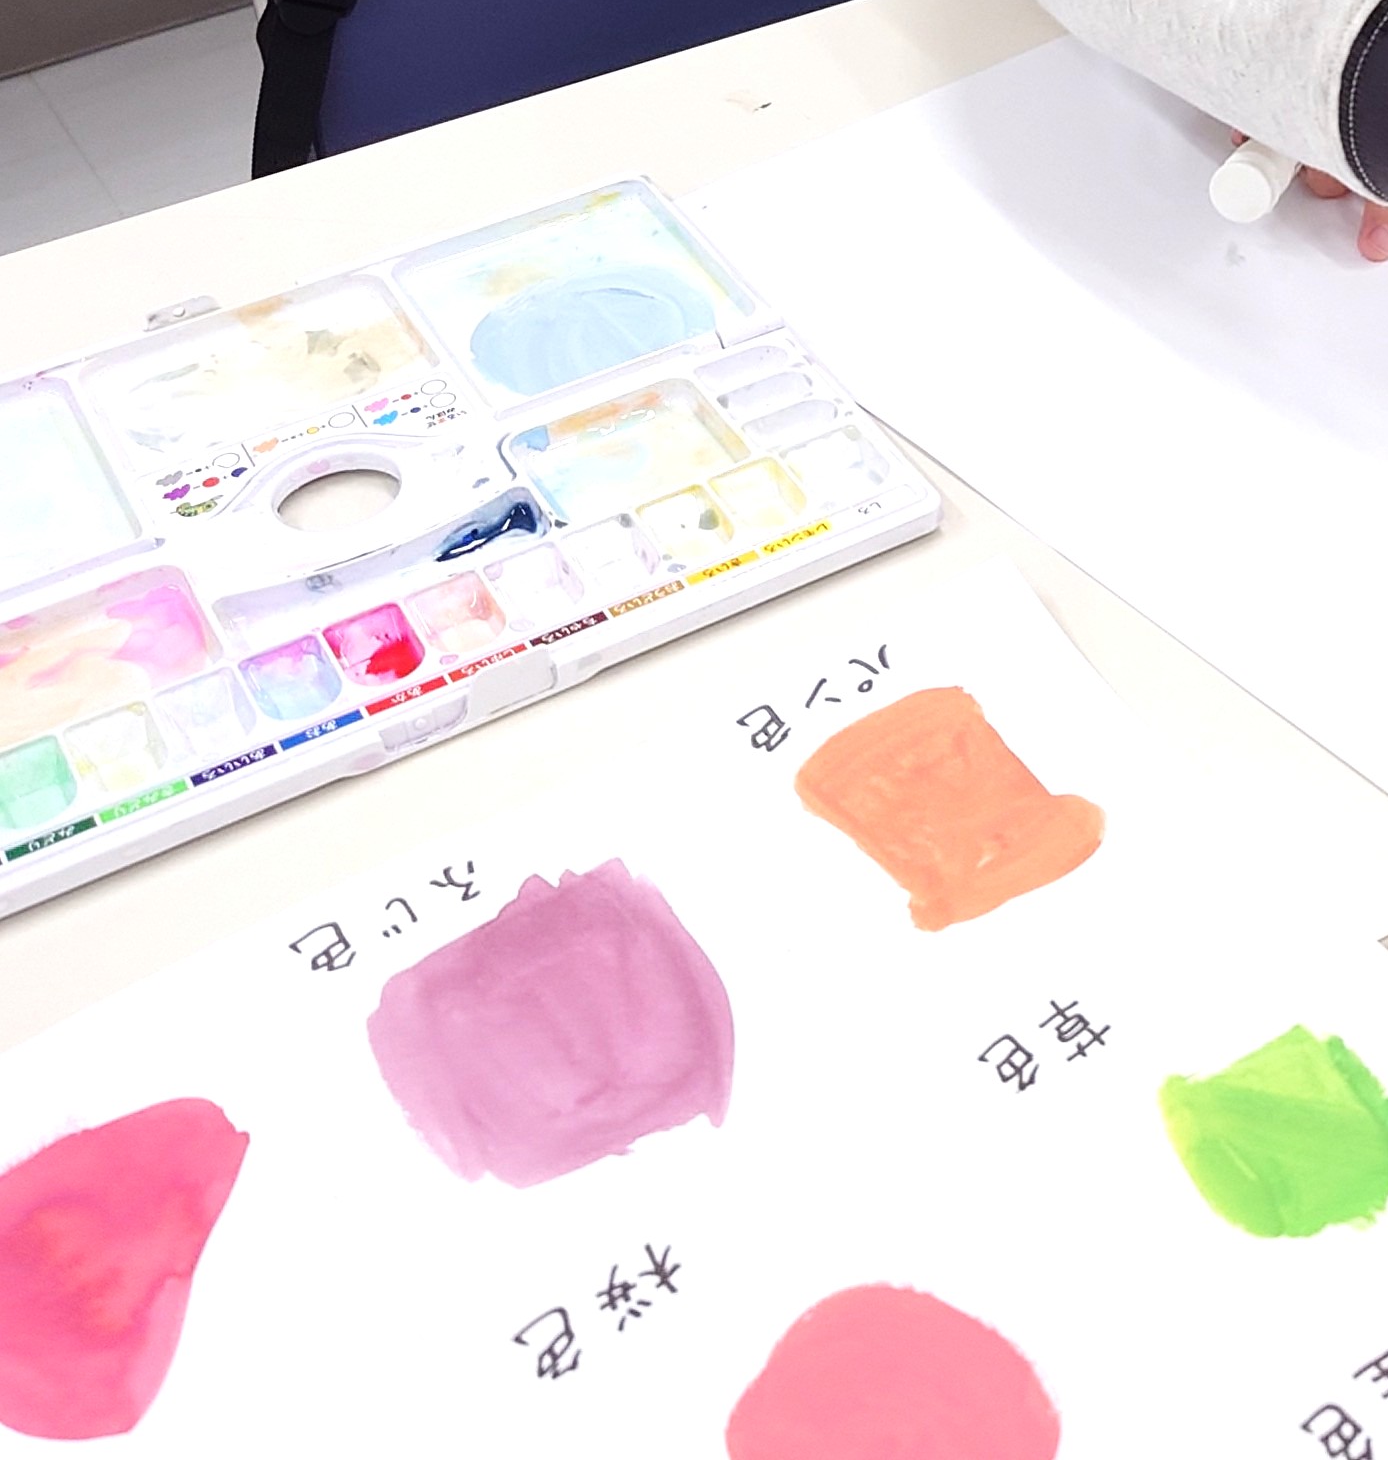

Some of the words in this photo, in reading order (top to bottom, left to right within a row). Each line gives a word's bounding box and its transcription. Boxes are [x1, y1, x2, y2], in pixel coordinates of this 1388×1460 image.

[857, 501, 881, 515] しろ
[763, 523, 829, 553] レモンいろ
[702, 557, 742, 578] きいろ
[613, 580, 680, 614] おうどいろ
[541, 616, 598, 645] ちゃいろ
[390, 685, 422, 704] あか
[736, 644, 889, 752] パン色
[305, 719, 338, 740] あお
[202, 748, 266, 781] あいいろ
[113, 785, 174, 817] きみどり
[28, 824, 75, 852] みどり
[289, 861, 480, 972] ふじ色
[978, 1000, 1110, 1091] 草色
[514, 1244, 680, 1379] 桜色
